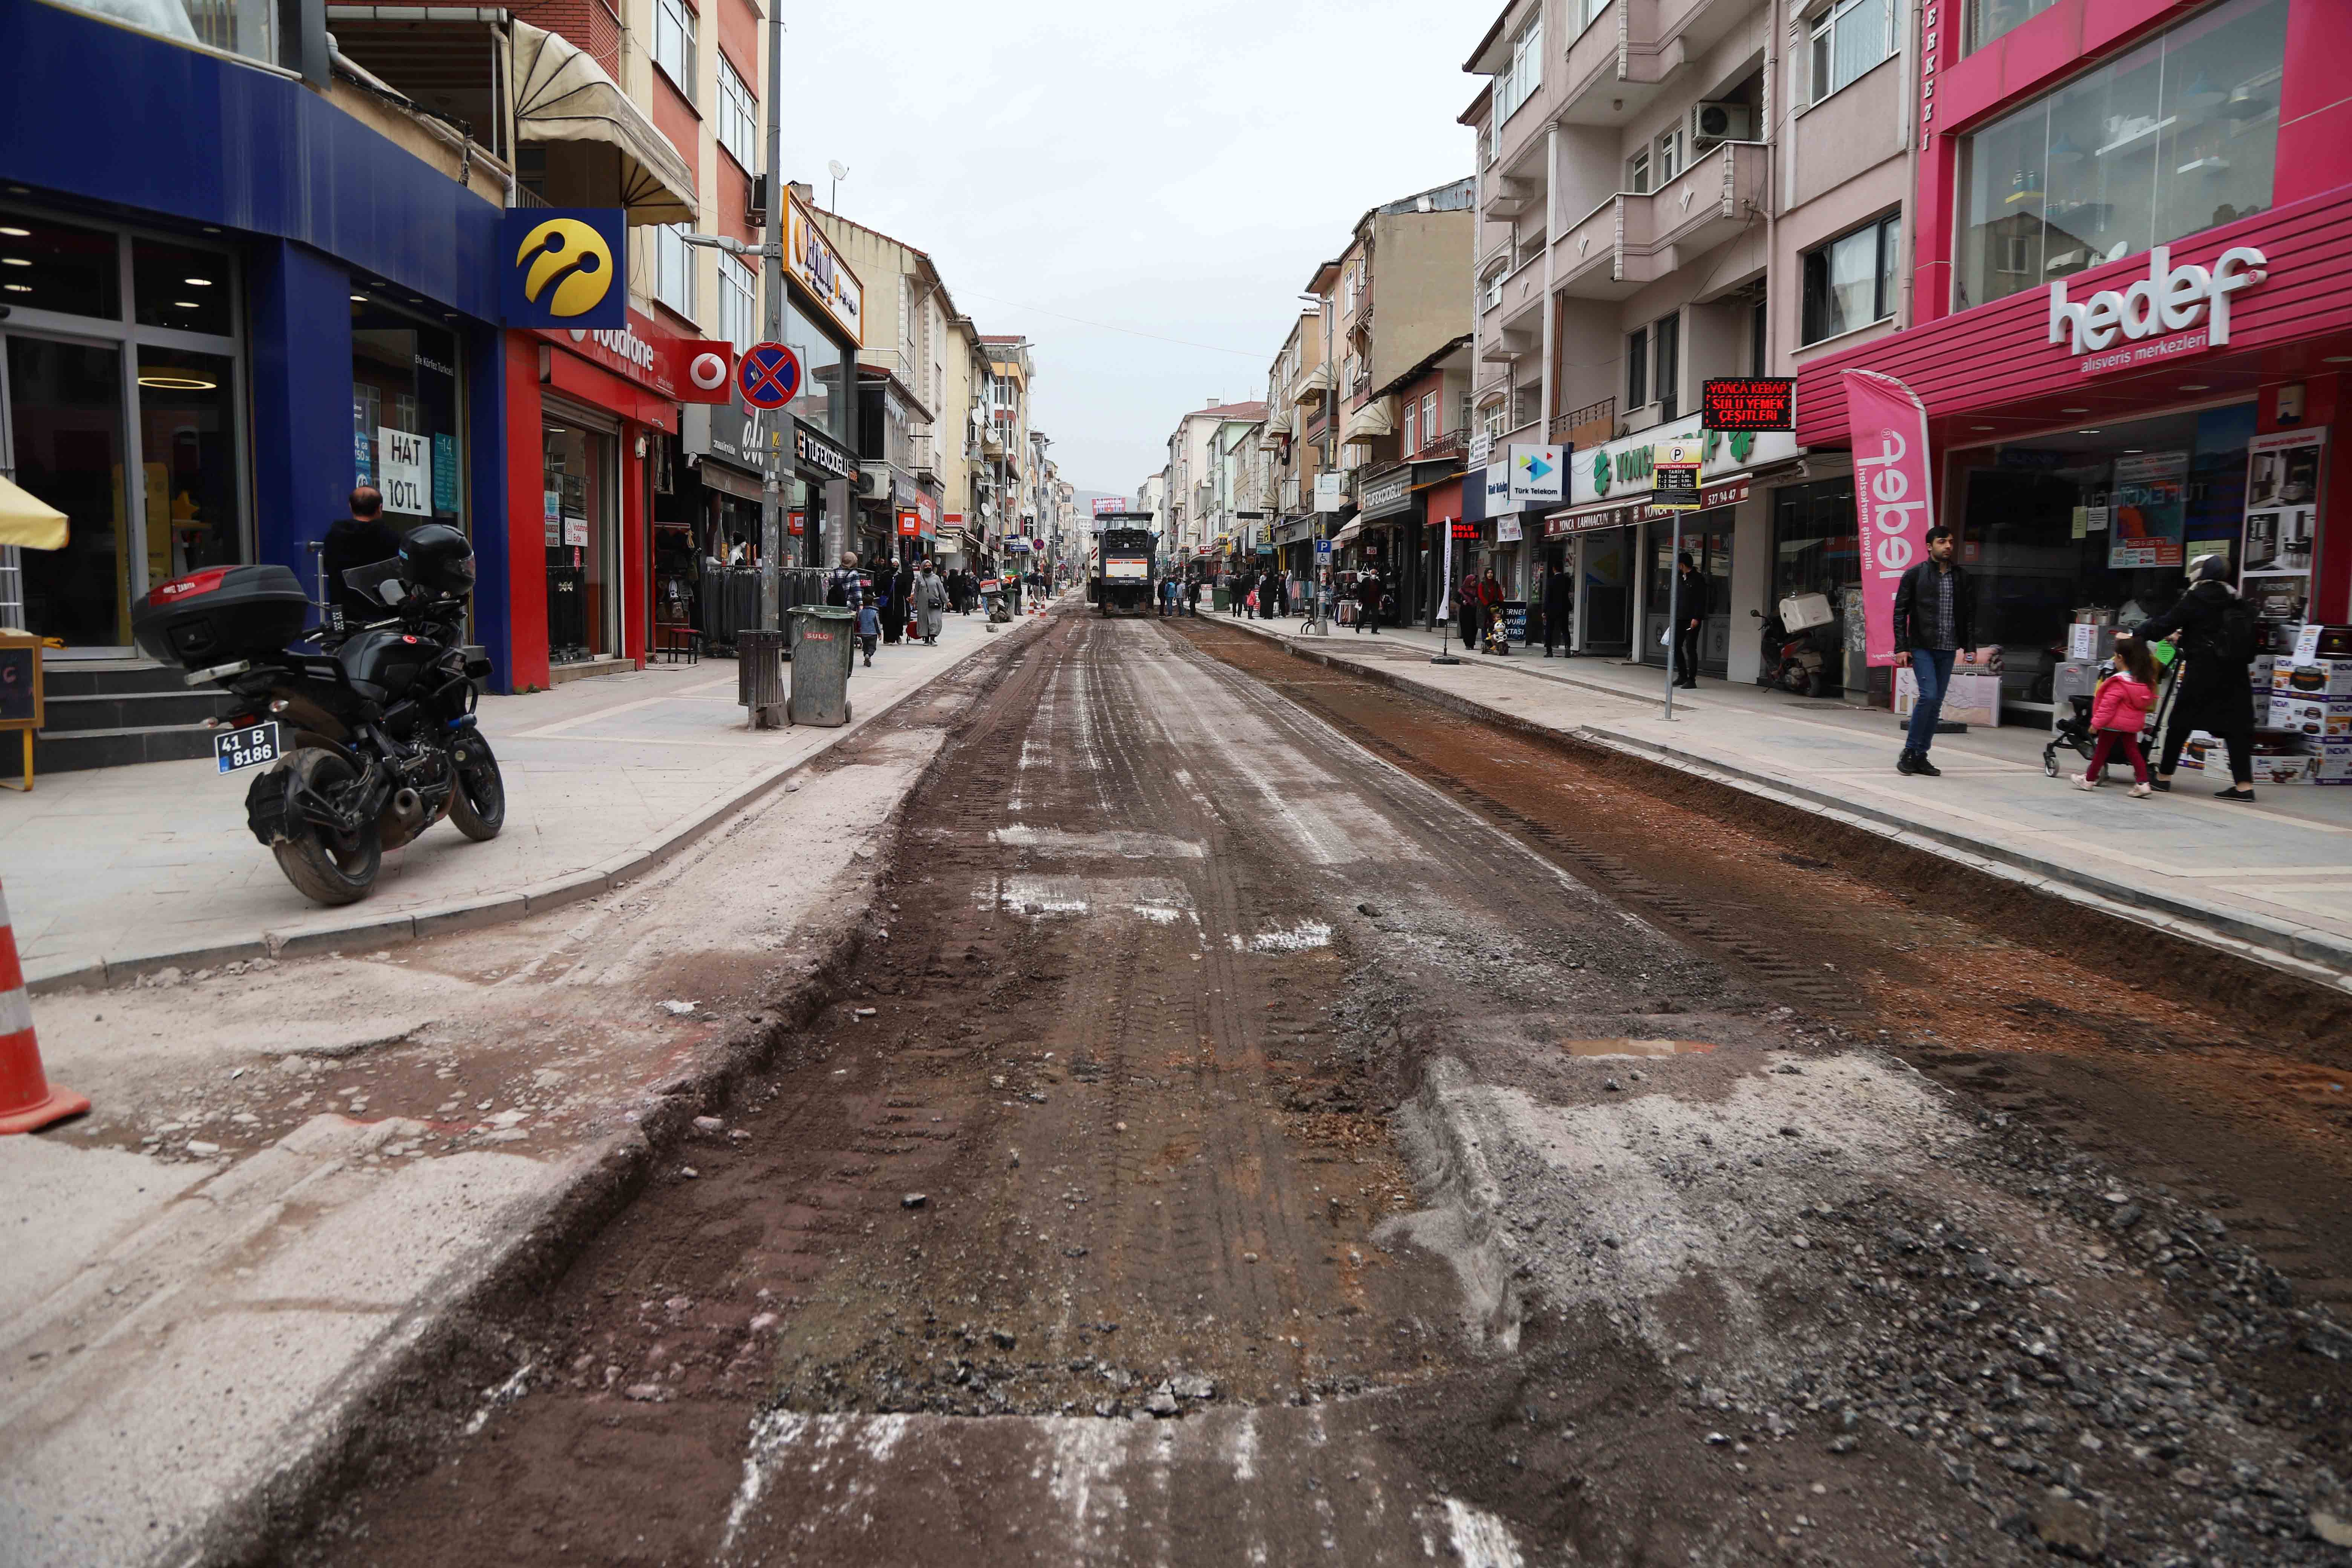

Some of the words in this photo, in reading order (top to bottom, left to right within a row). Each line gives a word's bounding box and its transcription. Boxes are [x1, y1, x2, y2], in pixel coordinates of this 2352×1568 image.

[1924, 0, 1937, 151] ERKEZİ
[2049, 246, 2268, 355] hedef
[2082, 351, 2131, 373] alışveriş
[2135, 330, 2206, 360] merkezleri
[1710, 384, 1749, 394] YONCA
[1751, 384, 1787, 394] KEBAP
[1713, 399, 1743, 409] SULU
[1746, 399, 1785, 409] YEMEK
[1718, 410, 1778, 423] ÇEŞİTLERİ
[392, 434, 421, 466] HAT
[1674, 449, 1681, 460] P
[1708, 493, 1718, 505] 527
[1720, 492, 1727, 502] 94
[1729, 489, 1736, 500] 47
[573, 521, 588, 532] Vodafone
[1559, 519, 1574, 531] YONCA
[1577, 513, 1609, 527] LAHMACUN
[1321, 542, 1328, 551] P
[222, 735, 241, 752] 41
[252, 730, 264, 745] B
[233, 744, 272, 766] 8186
